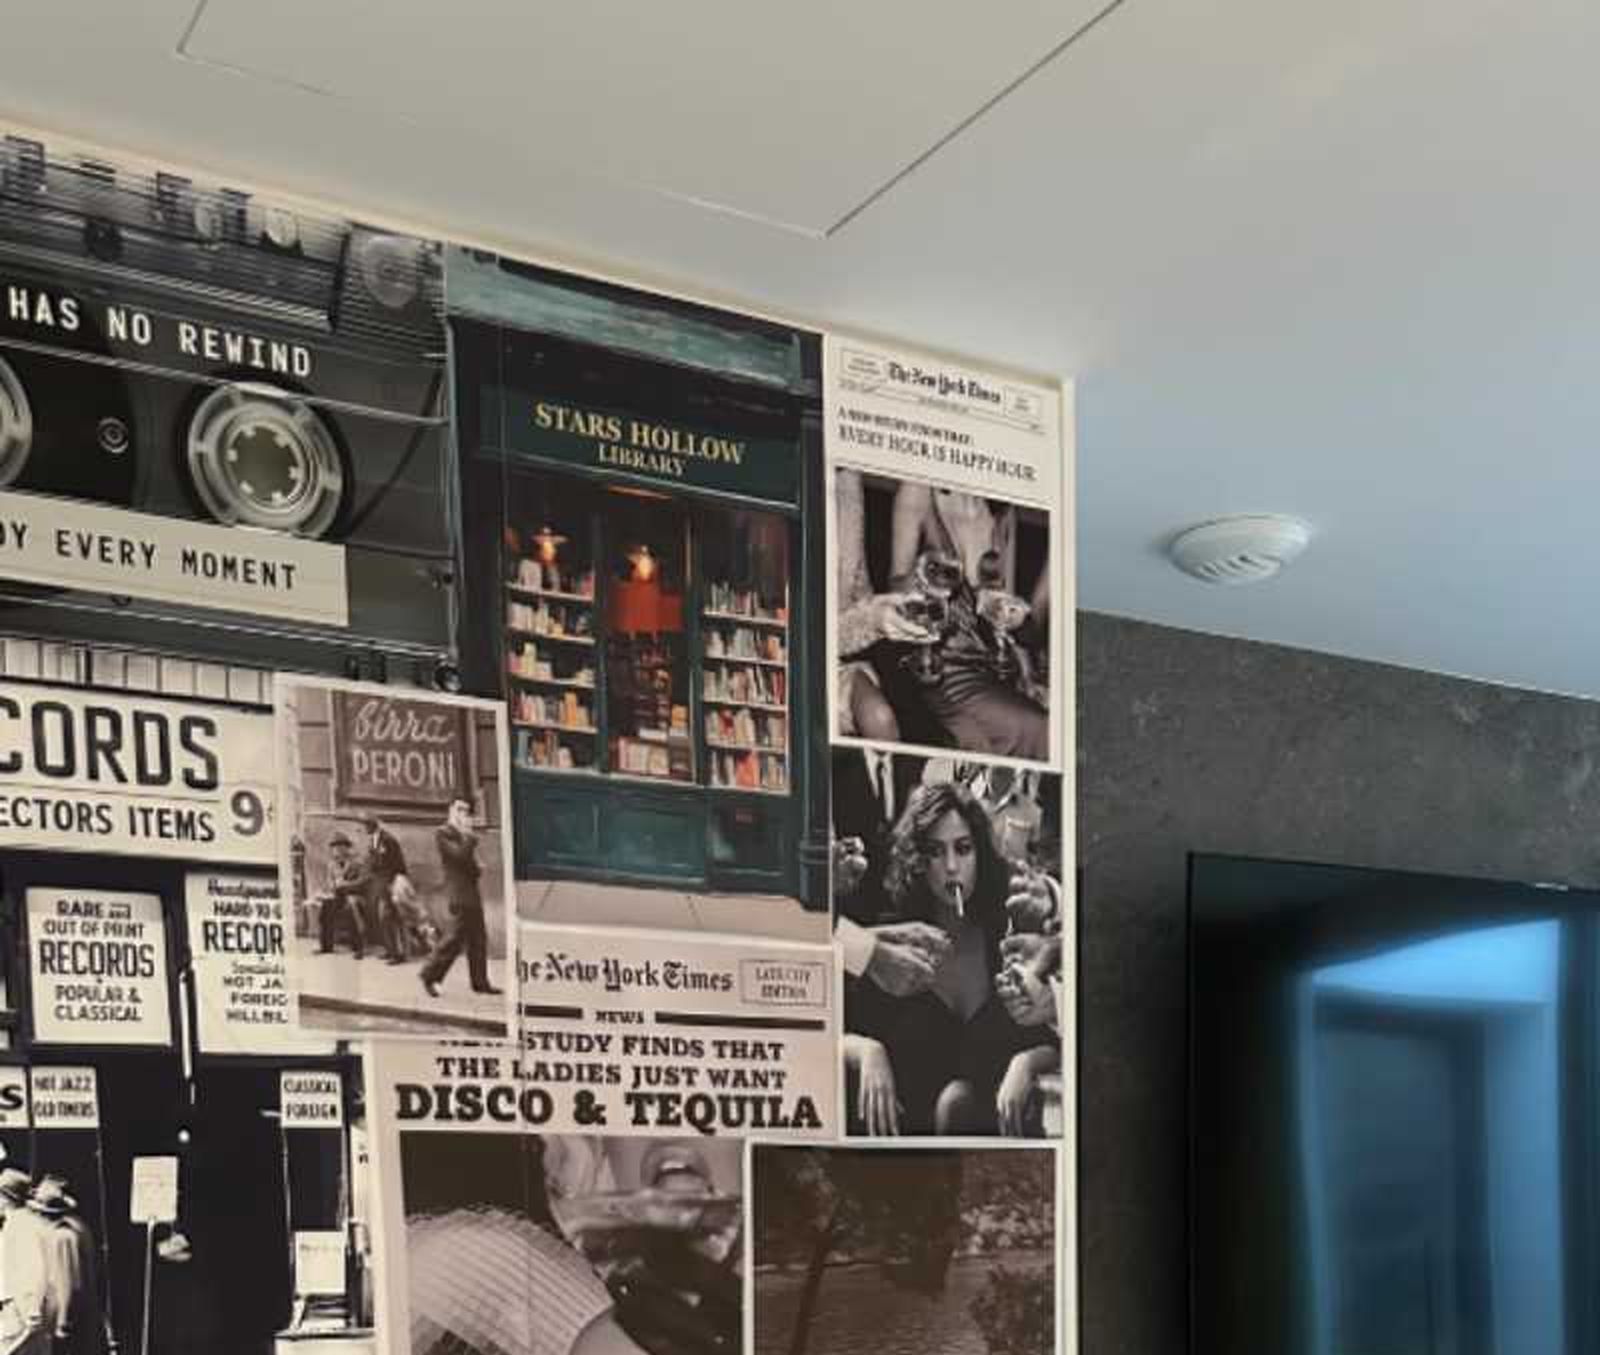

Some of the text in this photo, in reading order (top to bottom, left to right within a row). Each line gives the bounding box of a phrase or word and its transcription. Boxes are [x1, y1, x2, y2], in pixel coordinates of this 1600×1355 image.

[9, 287, 310, 377] HAS NO REWIND
[535, 402, 745, 464] STARS HOLLOW
[599, 444, 684, 476] LIBRARY
[951, 449, 992, 469] HAPPY
[57, 530, 155, 569] EVERY
[181, 550, 296, 590] MOMENT
[353, 750, 455, 787] PERONI
[129, 806, 215, 843] ITEMS
[57, 900, 103, 918] RARE
[44, 920, 144, 938] OUT OF PRINT
[203, 920, 285, 956] RECOR
[40, 941, 155, 977] RECORDS
[547, 953, 598, 983] New
[603, 957, 659, 992] York
[663, 961, 733, 993] Times
[56, 985, 123, 1002] POPULAR
[55, 1005, 142, 1022] CLASSICAL
[595, 1010, 644, 1025] NEWS
[518, 1029, 612, 1053] STUDY
[623, 1035, 704, 1059] FINDS
[713, 1040, 784, 1061] THAT
[437, 1057, 786, 1090] THE LADIES JUST WANT
[395, 1084, 822, 1135] DISCO & TEQUILA
